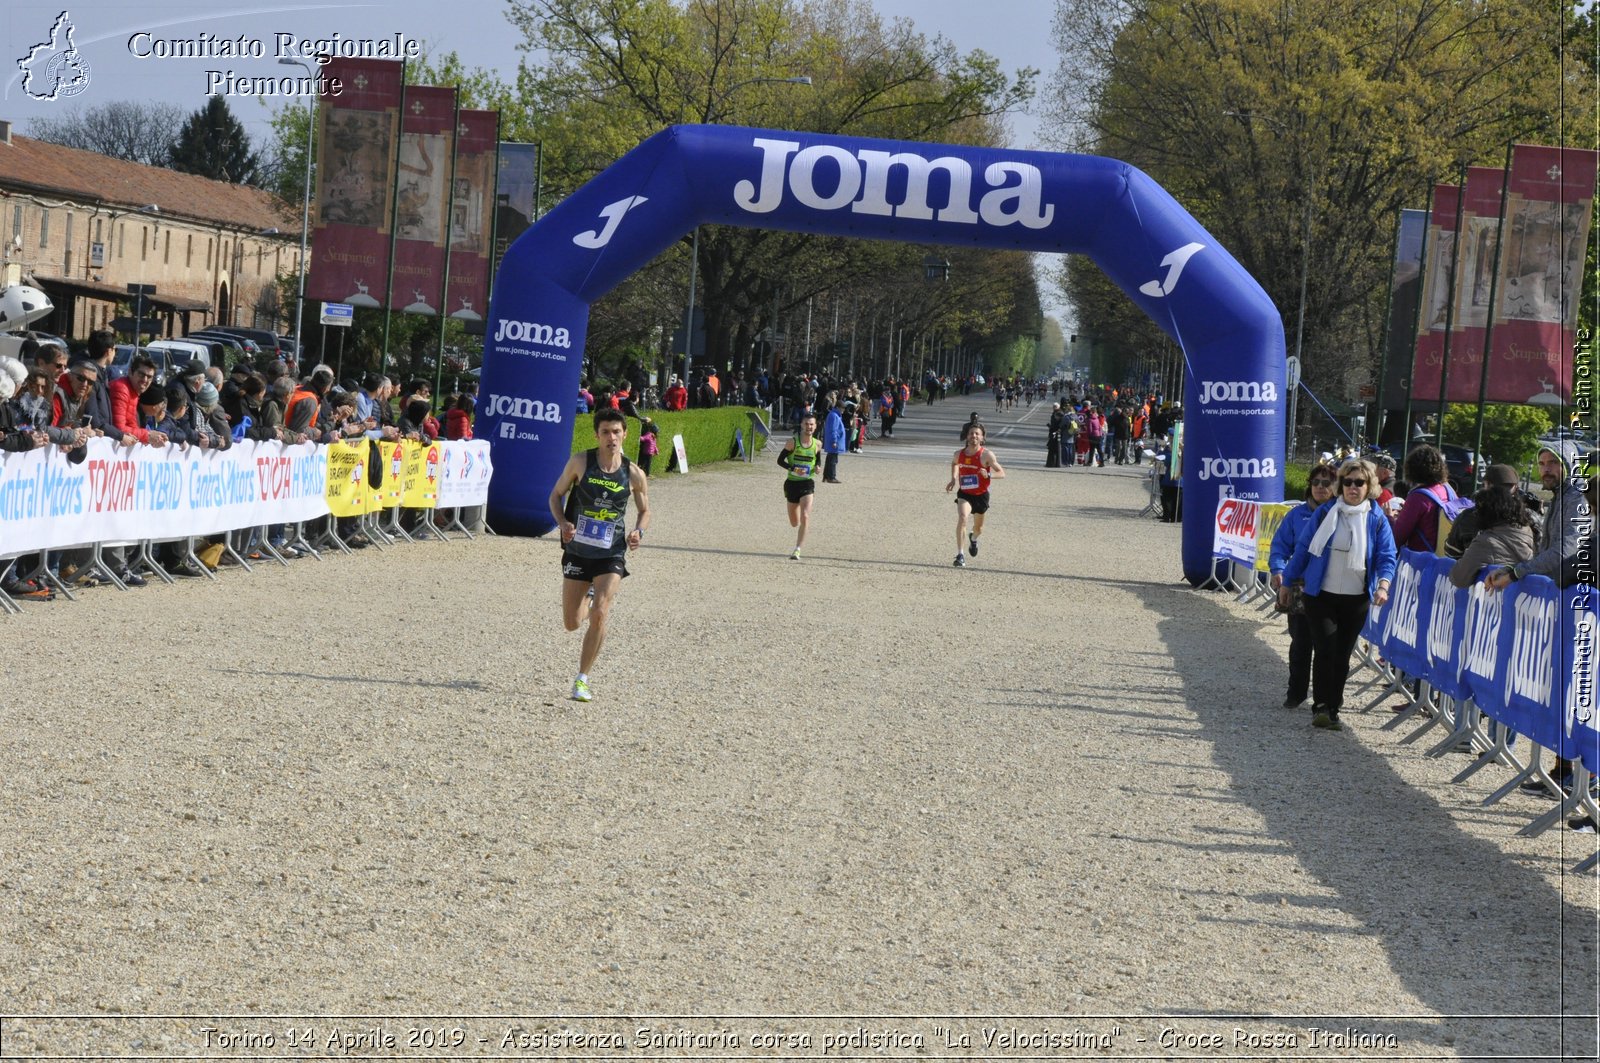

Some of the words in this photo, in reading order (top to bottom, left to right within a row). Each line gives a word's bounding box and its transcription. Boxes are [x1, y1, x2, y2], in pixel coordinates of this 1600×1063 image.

[495, 346, 567, 361] www.joma-sport.com
[517, 432, 540, 441] JOMA
[588, 477, 618, 488] saucony
[592, 525, 598, 534] 8
